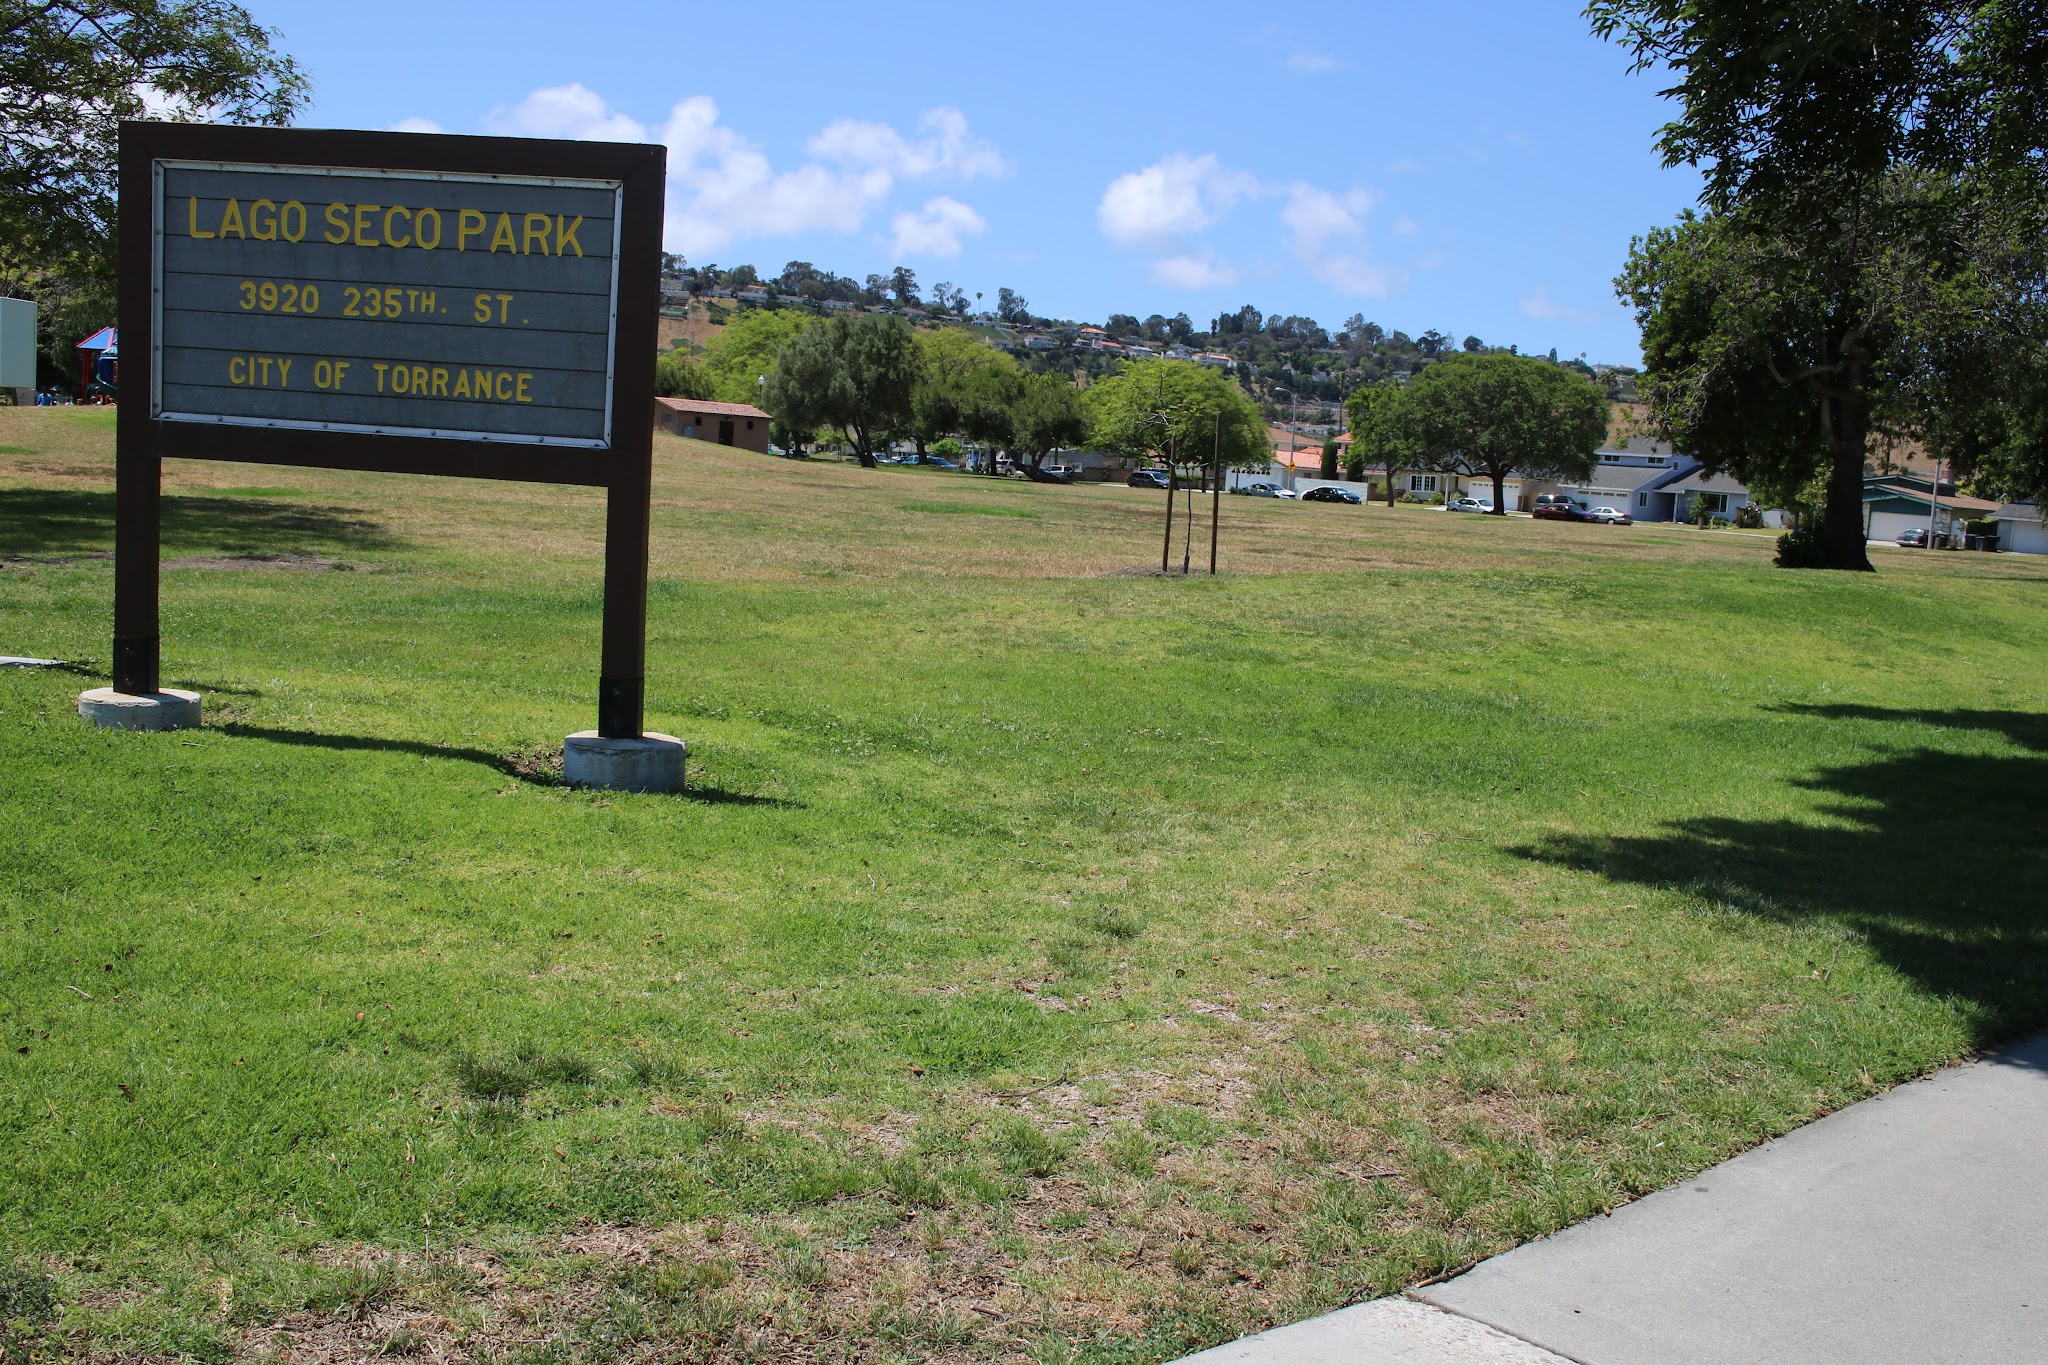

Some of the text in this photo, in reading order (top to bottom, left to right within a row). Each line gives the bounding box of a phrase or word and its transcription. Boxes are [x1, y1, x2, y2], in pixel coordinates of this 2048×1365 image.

[189, 196, 584, 257] LAGO SECO PARK
[239, 280, 320, 313] 3920
[342, 287, 448, 318] 235TH.
[229, 356, 533, 402] CITY OF TORRANCE
